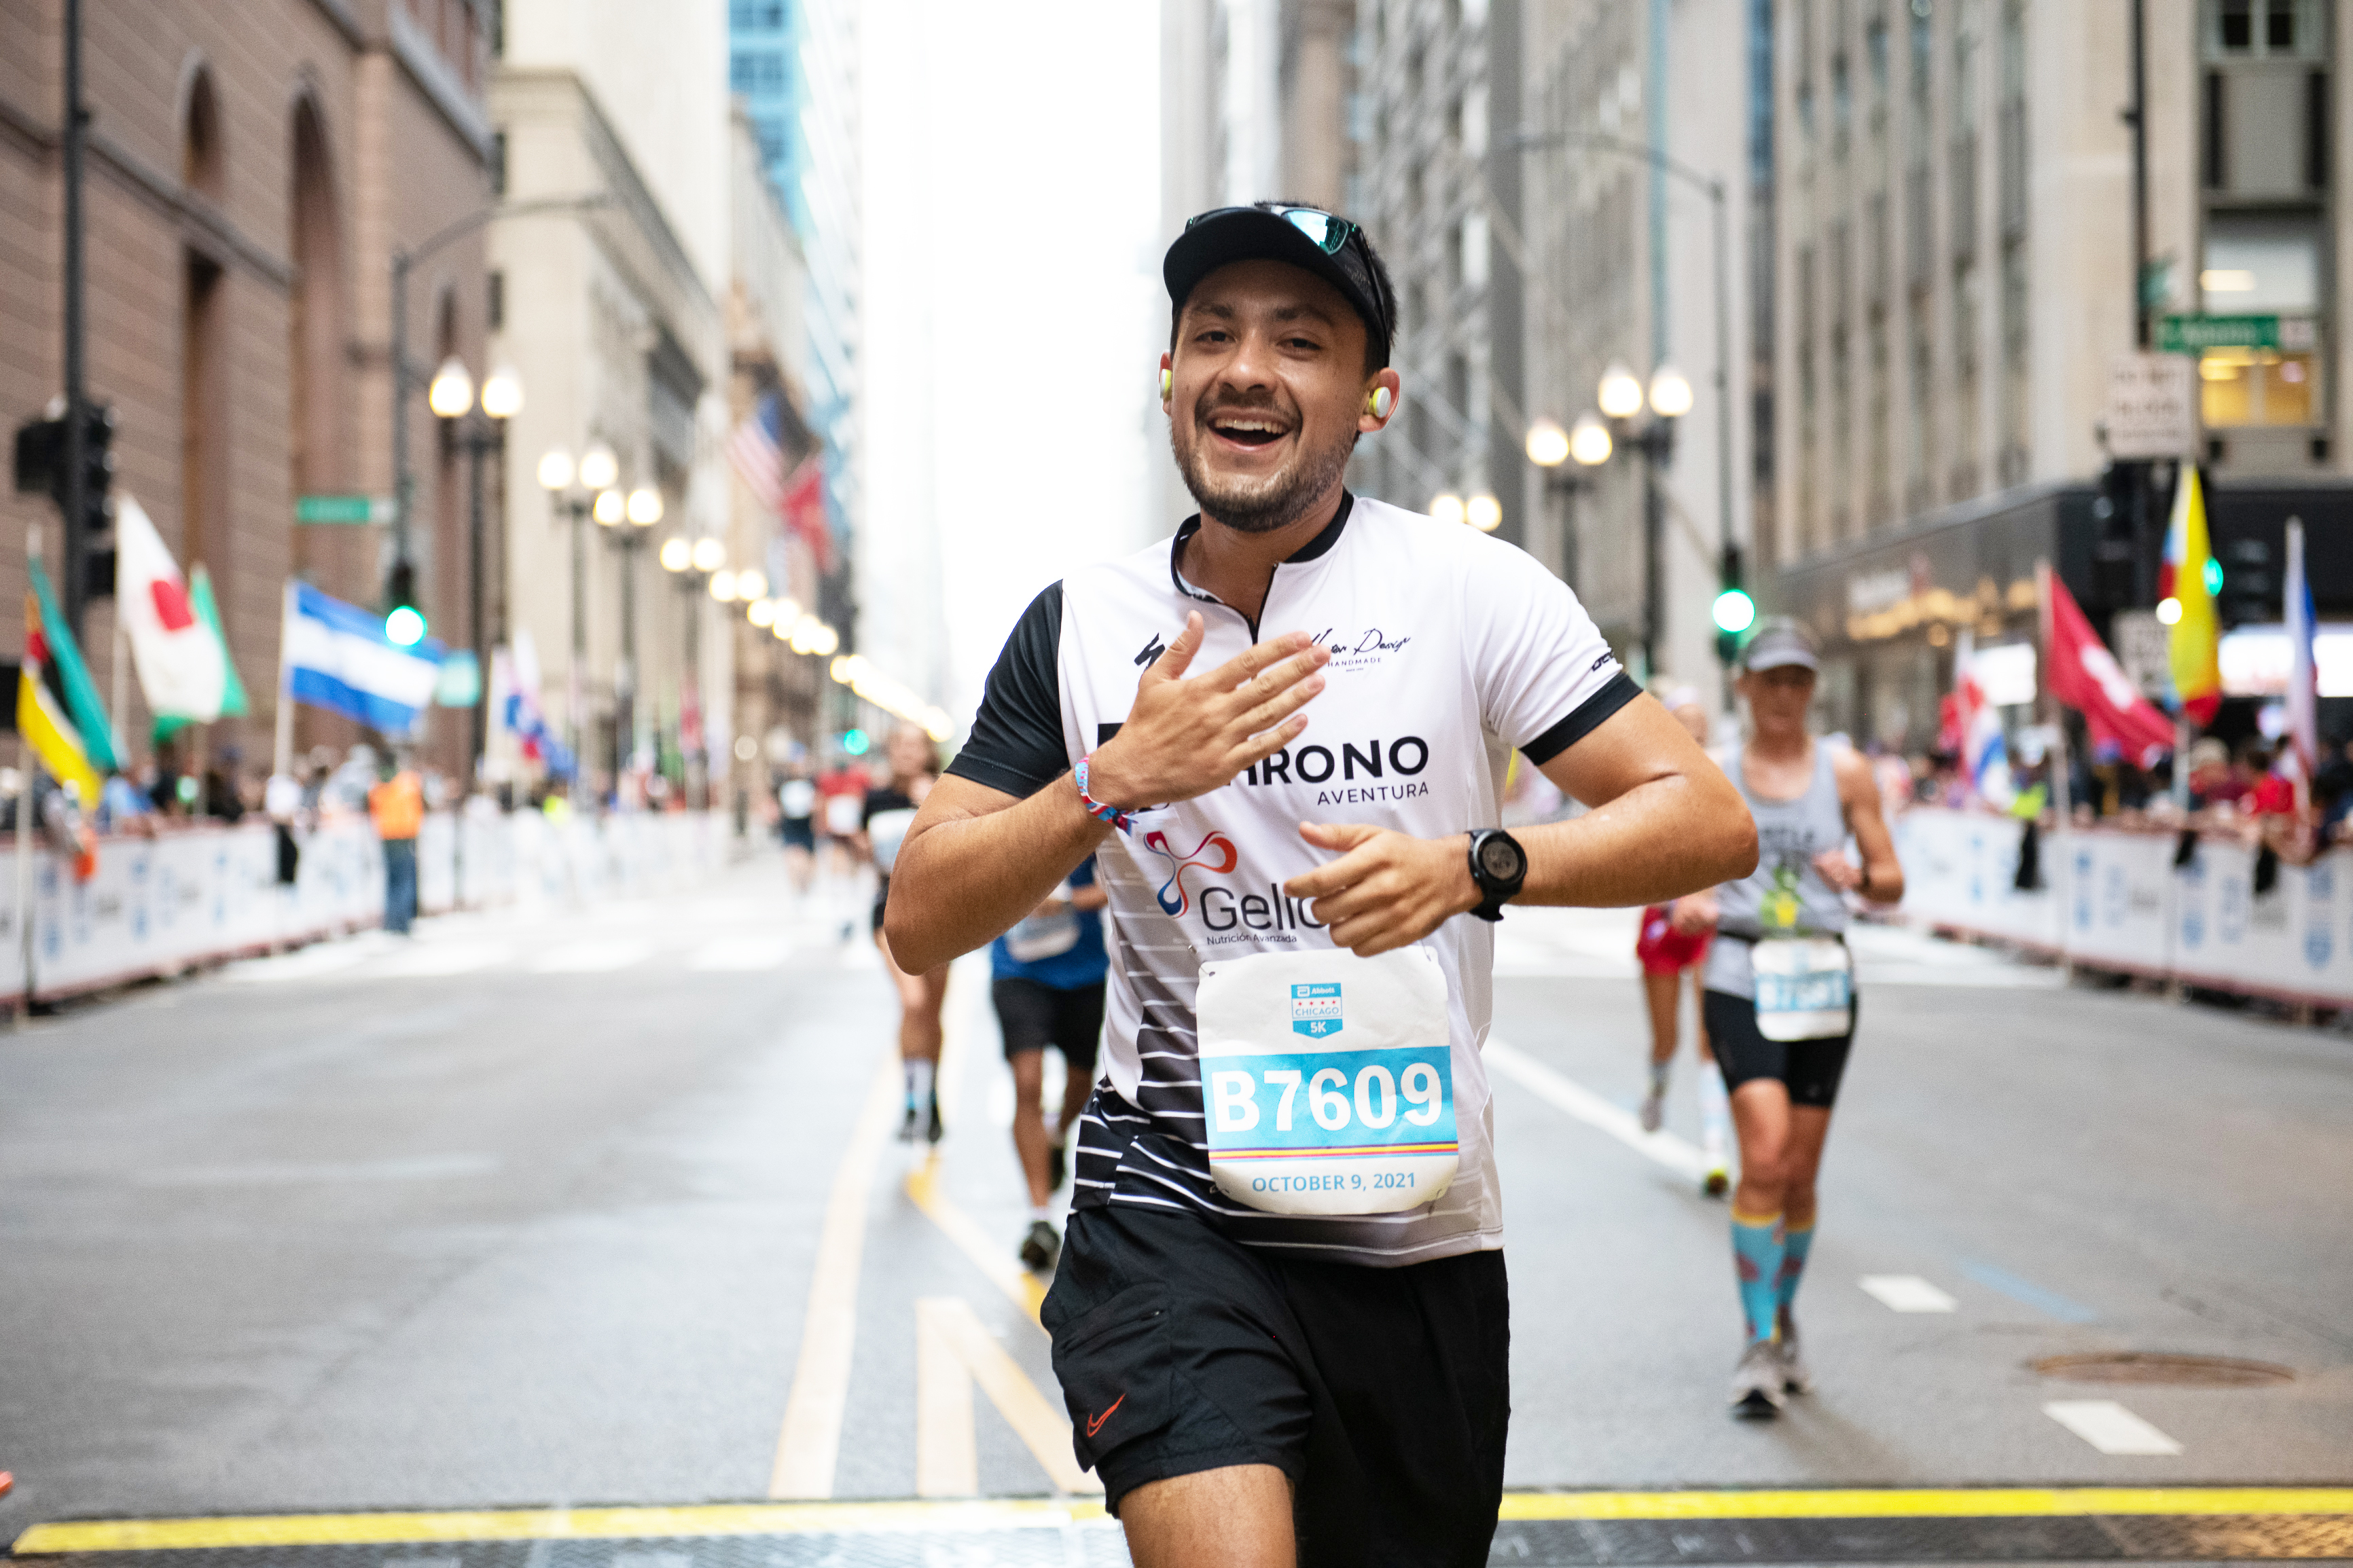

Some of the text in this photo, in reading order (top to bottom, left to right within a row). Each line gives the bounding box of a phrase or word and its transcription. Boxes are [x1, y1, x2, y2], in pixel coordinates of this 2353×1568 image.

[1353, 627, 1411, 656] Design
[1327, 657, 1382, 667] HANDMADE
[1317, 781, 1429, 806] AVENTURA
[1206, 932, 1297, 945] Nutrición Avanzada
[1295, 1006, 1340, 1016] CHICAGO
[1310, 1021, 1327, 1033] 5K
[1211, 1062, 1443, 1133] B7609
[1252, 1172, 1415, 1192] OCTOBER 9, 2021
